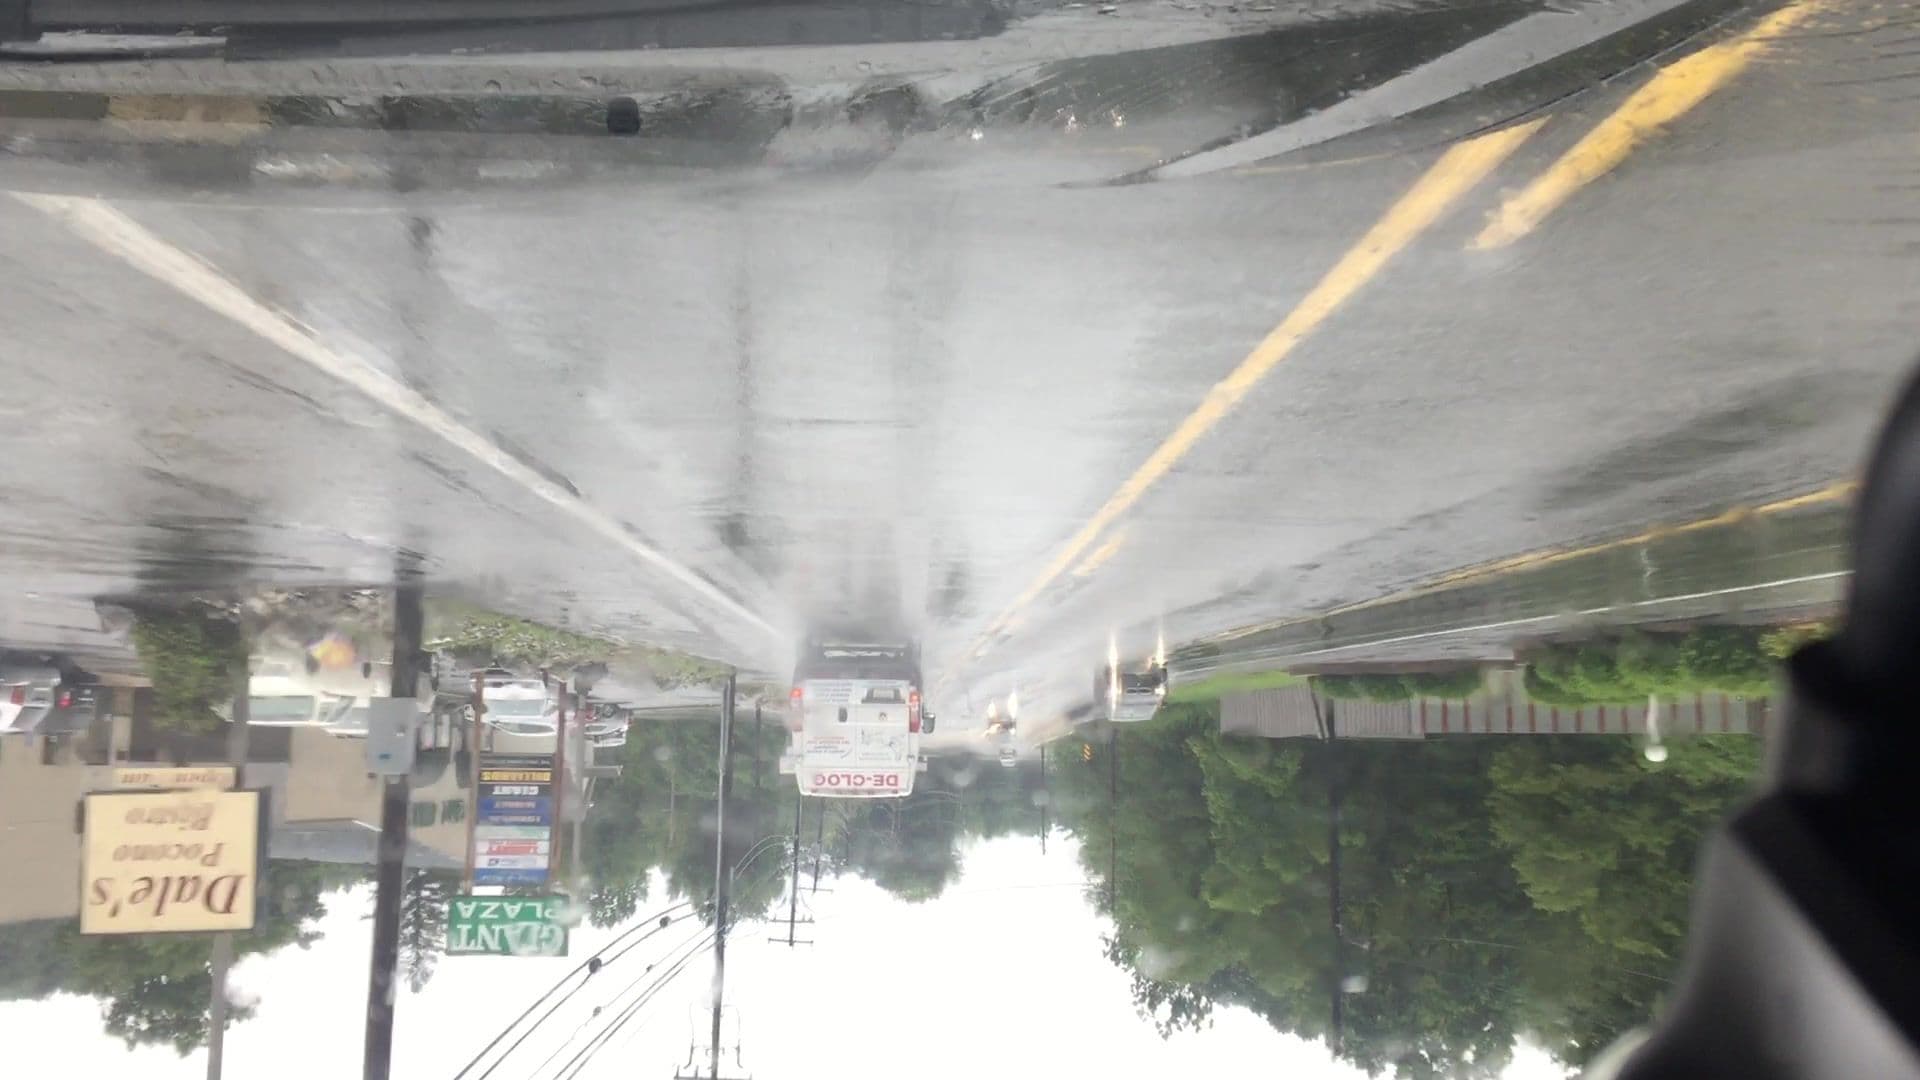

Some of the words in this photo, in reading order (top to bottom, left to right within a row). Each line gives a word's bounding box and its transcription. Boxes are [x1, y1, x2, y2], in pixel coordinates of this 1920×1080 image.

[112, 843, 225, 867] Pocono
[89, 874, 248, 918] Dale's
[455, 901, 561, 919] PLAZA
[451, 921, 565, 953] GIANT
